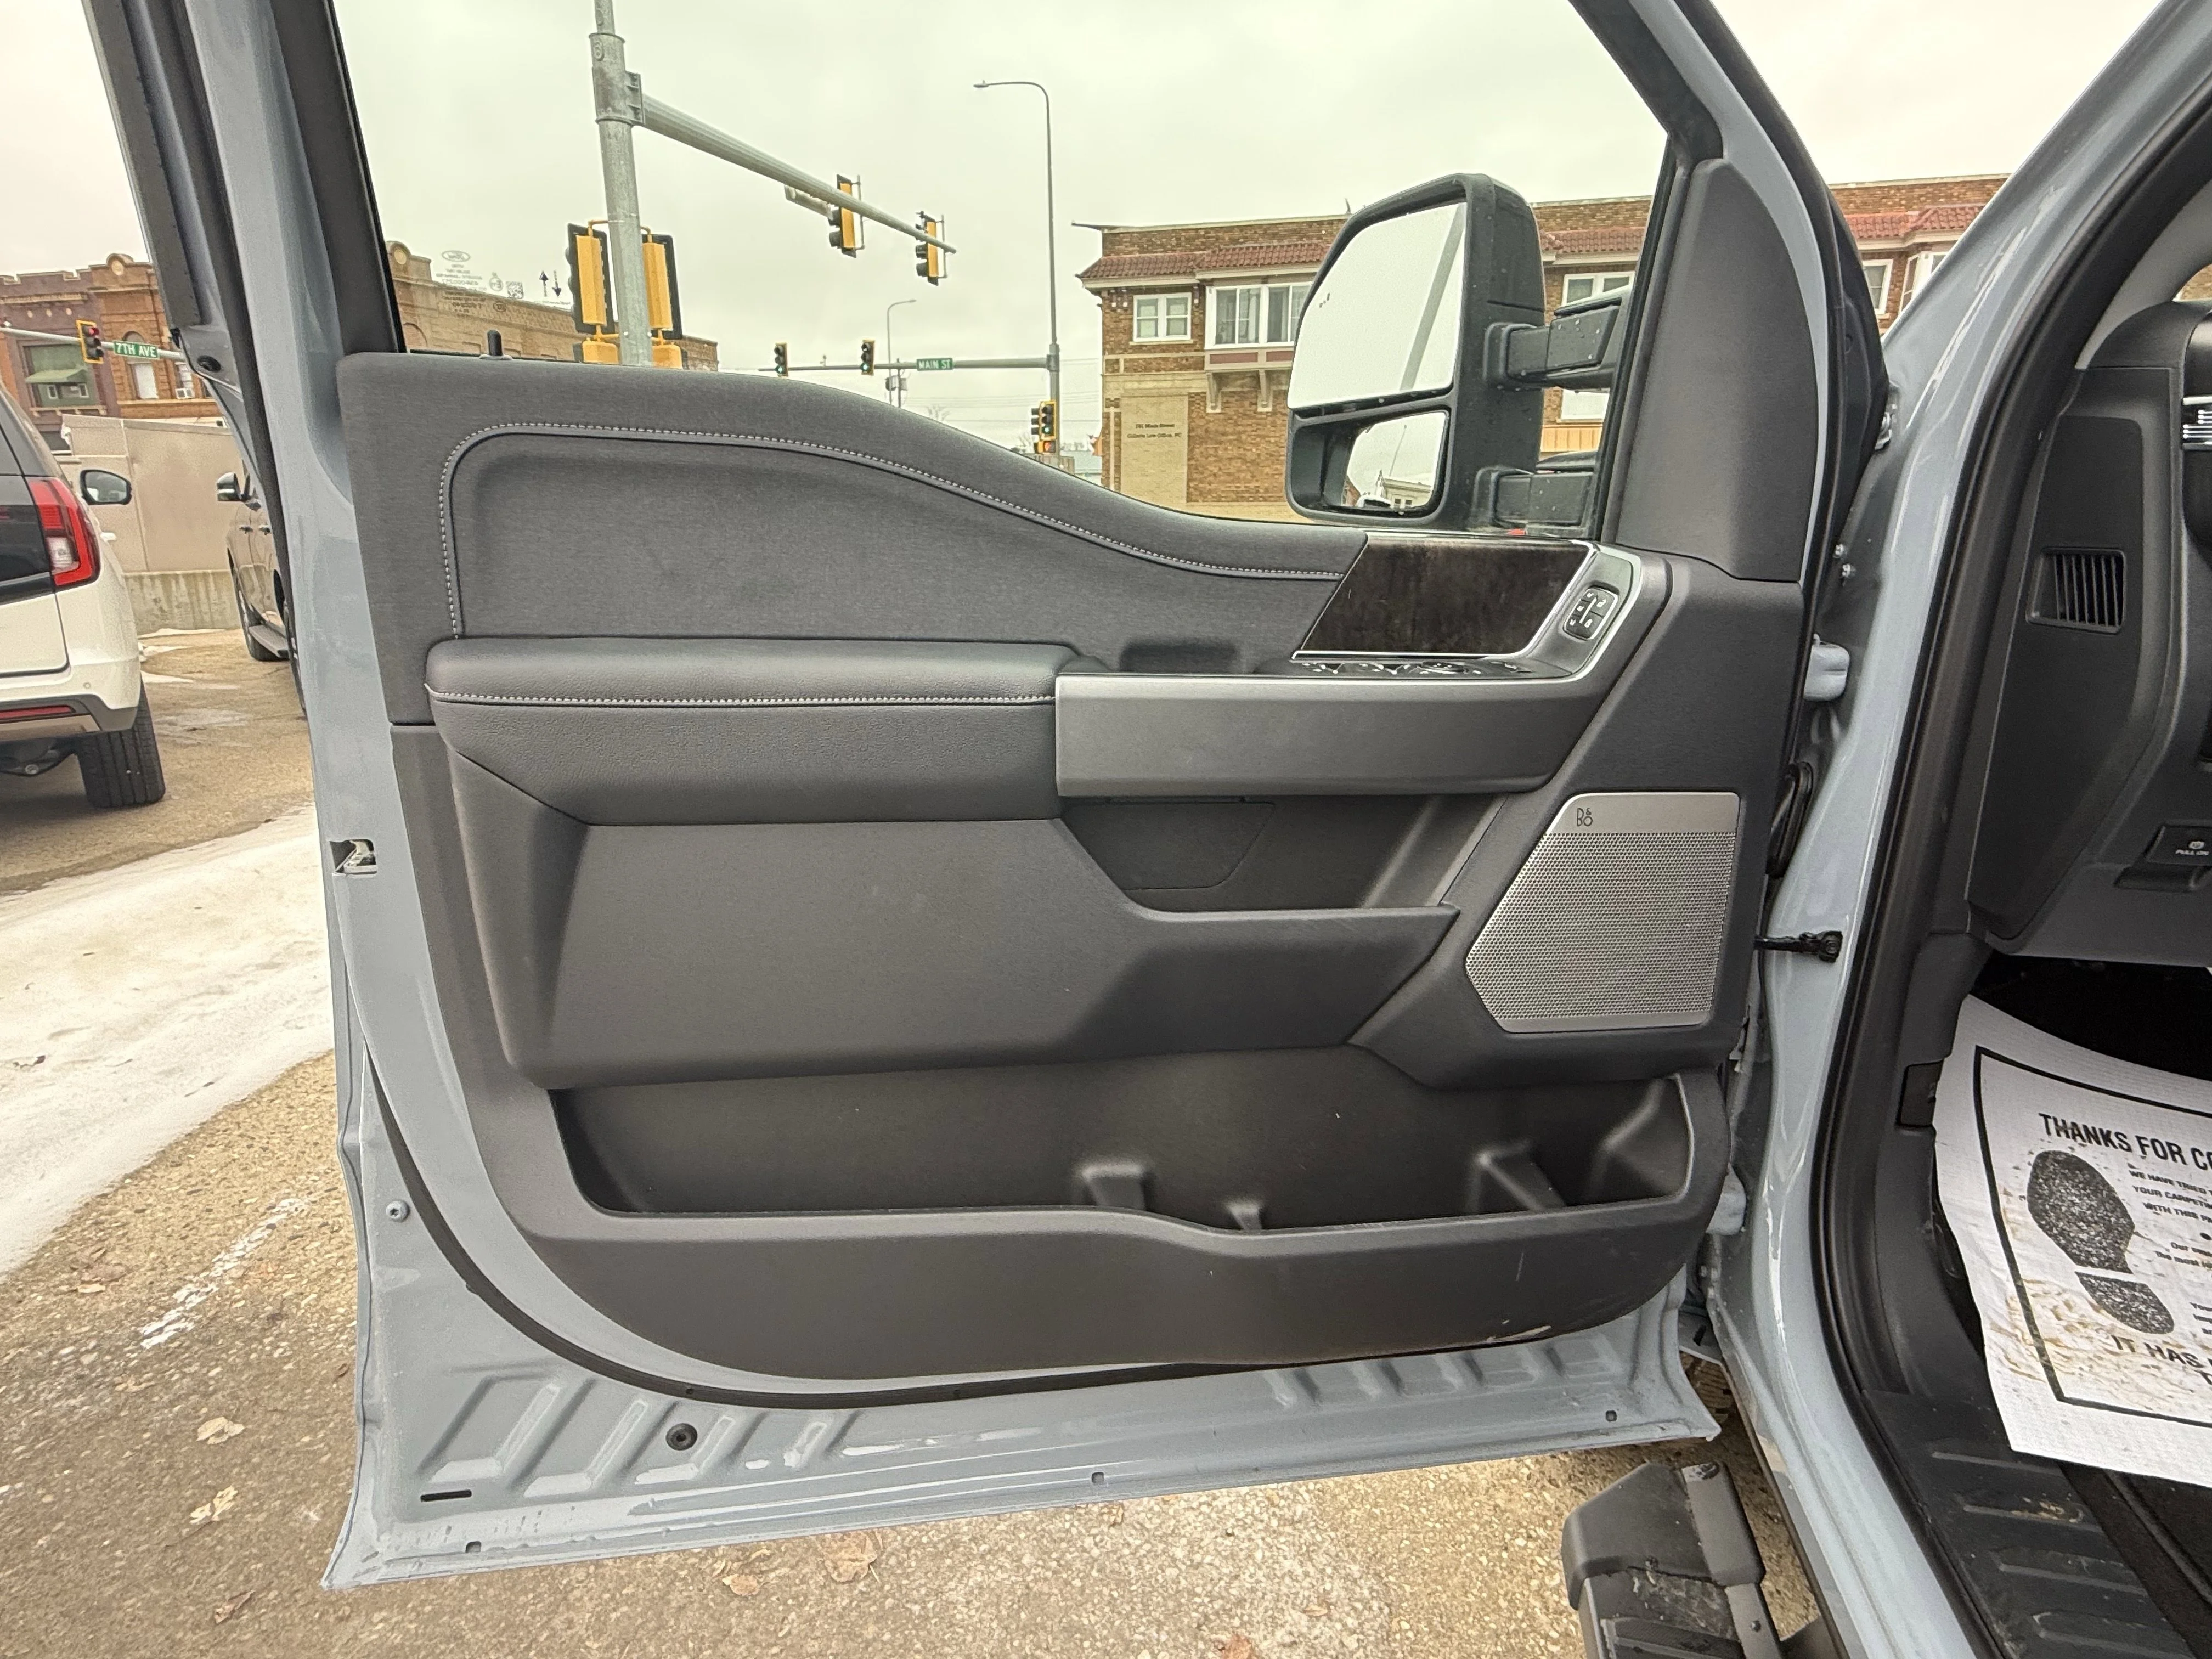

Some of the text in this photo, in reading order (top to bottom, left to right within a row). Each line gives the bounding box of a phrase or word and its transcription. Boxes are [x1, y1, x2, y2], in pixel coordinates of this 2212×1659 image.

[116, 342, 157, 357] 7TH AVE
[918, 359, 950, 369] MAIN ST
[2038, 1113, 2132, 1153] THANKS
[2135, 1135, 2188, 1165] FOR
[2129, 1170, 2146, 1179] WE
[2147, 1173, 2175, 1186] HAVE
[2132, 1185, 2163, 1197] YOUR
[2142, 1202, 2172, 1214] WITH
[2173, 1208, 2199, 1219] THIS
[2111, 1334, 2136, 1352] IT
[2144, 1342, 2206, 1368] HAS
